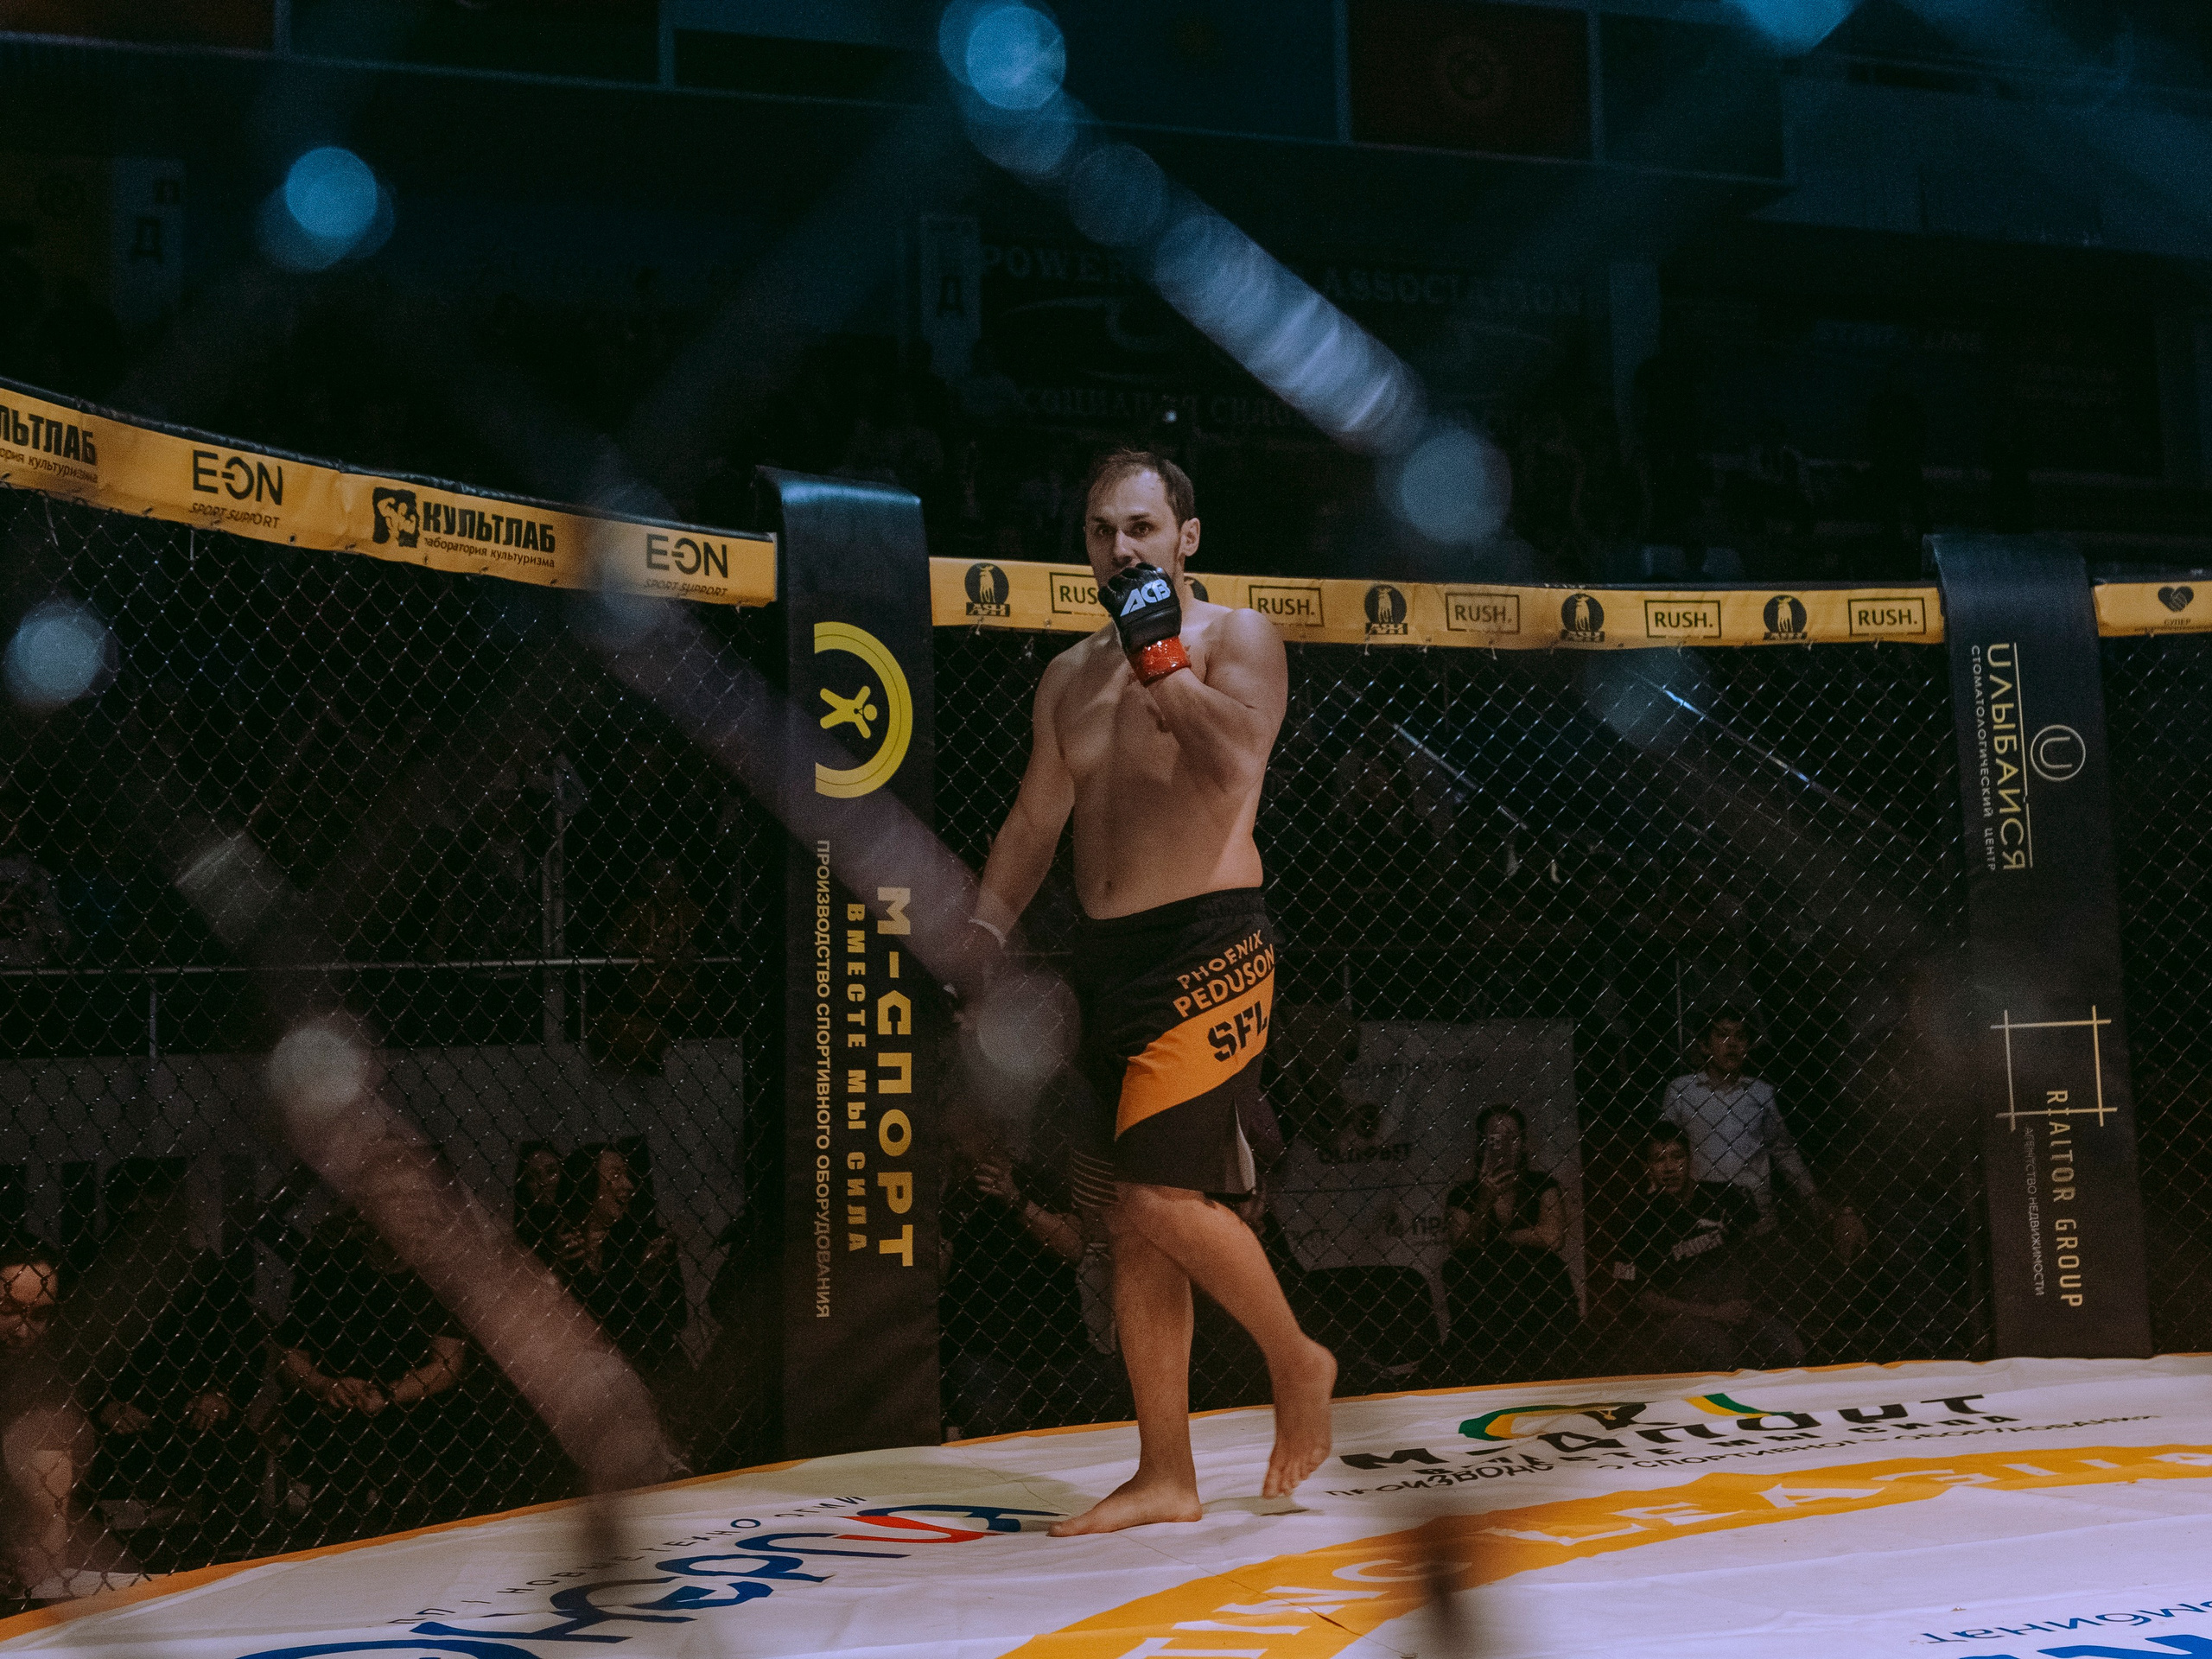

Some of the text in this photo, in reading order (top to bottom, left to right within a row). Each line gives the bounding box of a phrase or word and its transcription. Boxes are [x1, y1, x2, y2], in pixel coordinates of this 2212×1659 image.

[423, 501, 556, 554] КУЛЬТЛАБ
[490, 549, 556, 569] культуризма
[1059, 585, 1099, 605] RUS
[1257, 597, 1315, 616] RUSH.
[1454, 605, 1512, 624] RUSH.
[1654, 611, 1713, 628] RUSH.
[1858, 608, 1918, 626] RUSH.
[1971, 645, 1996, 871] СТОМАТОЛОГИЧЕСКИЙ ЦЕНТР
[1176, 929, 1263, 989] PHOENIX
[814, 840, 831, 1318] ПРОИЗВОДСТВО СПОРТИВНОГО ОБОРУДОВАНИЯ
[847, 903, 868, 1251] ВМЕСТЕ МЫ СИЛА
[877, 887, 913, 1267] М-СПОРТ
[2028, 1196, 2045, 1296] НЕДВИЖИМОСТИ
[2055, 1217, 2084, 1308] GROUP
